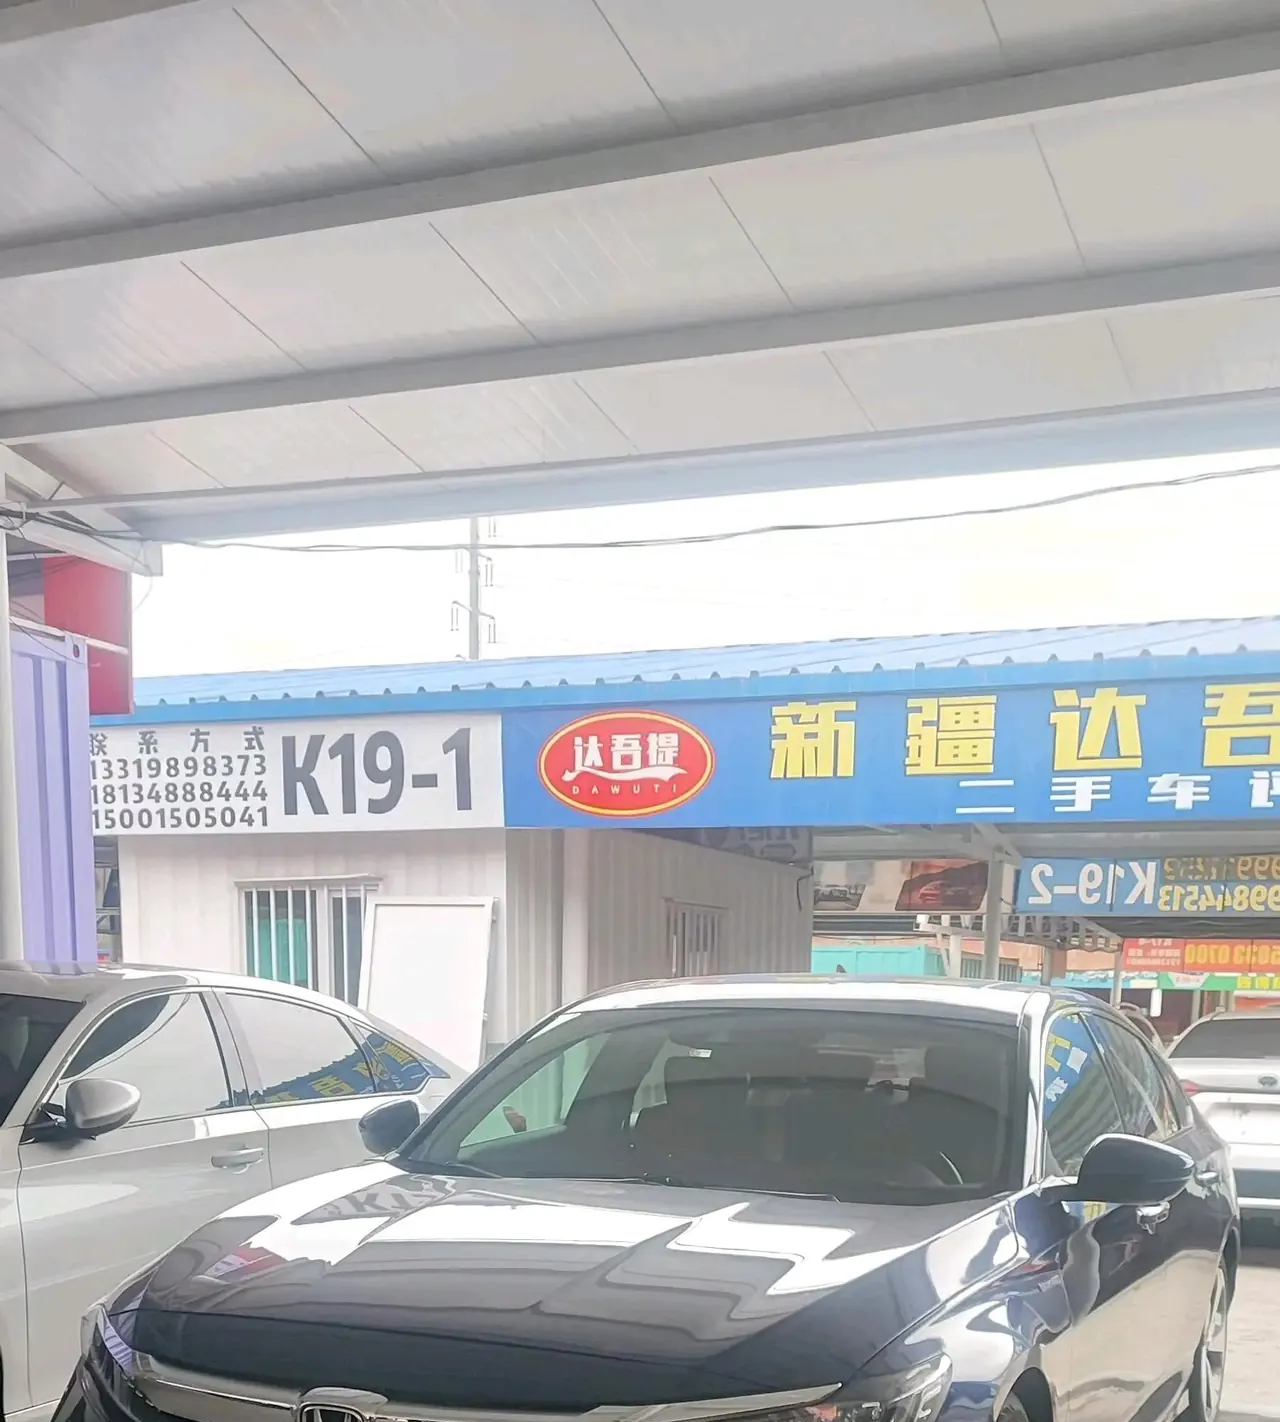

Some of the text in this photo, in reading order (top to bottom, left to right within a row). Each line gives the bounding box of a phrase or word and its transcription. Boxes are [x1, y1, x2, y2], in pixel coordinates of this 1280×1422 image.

[90, 726, 265, 755] 联系方式
[573, 732, 681, 771] 达吾提
[90, 754, 267, 780] 13319898373
[281, 728, 472, 815] K19-1
[91, 780, 268, 805] 18134888444
[572, 783, 678, 796] DAWUTI
[92, 805, 269, 829] 15001505041
